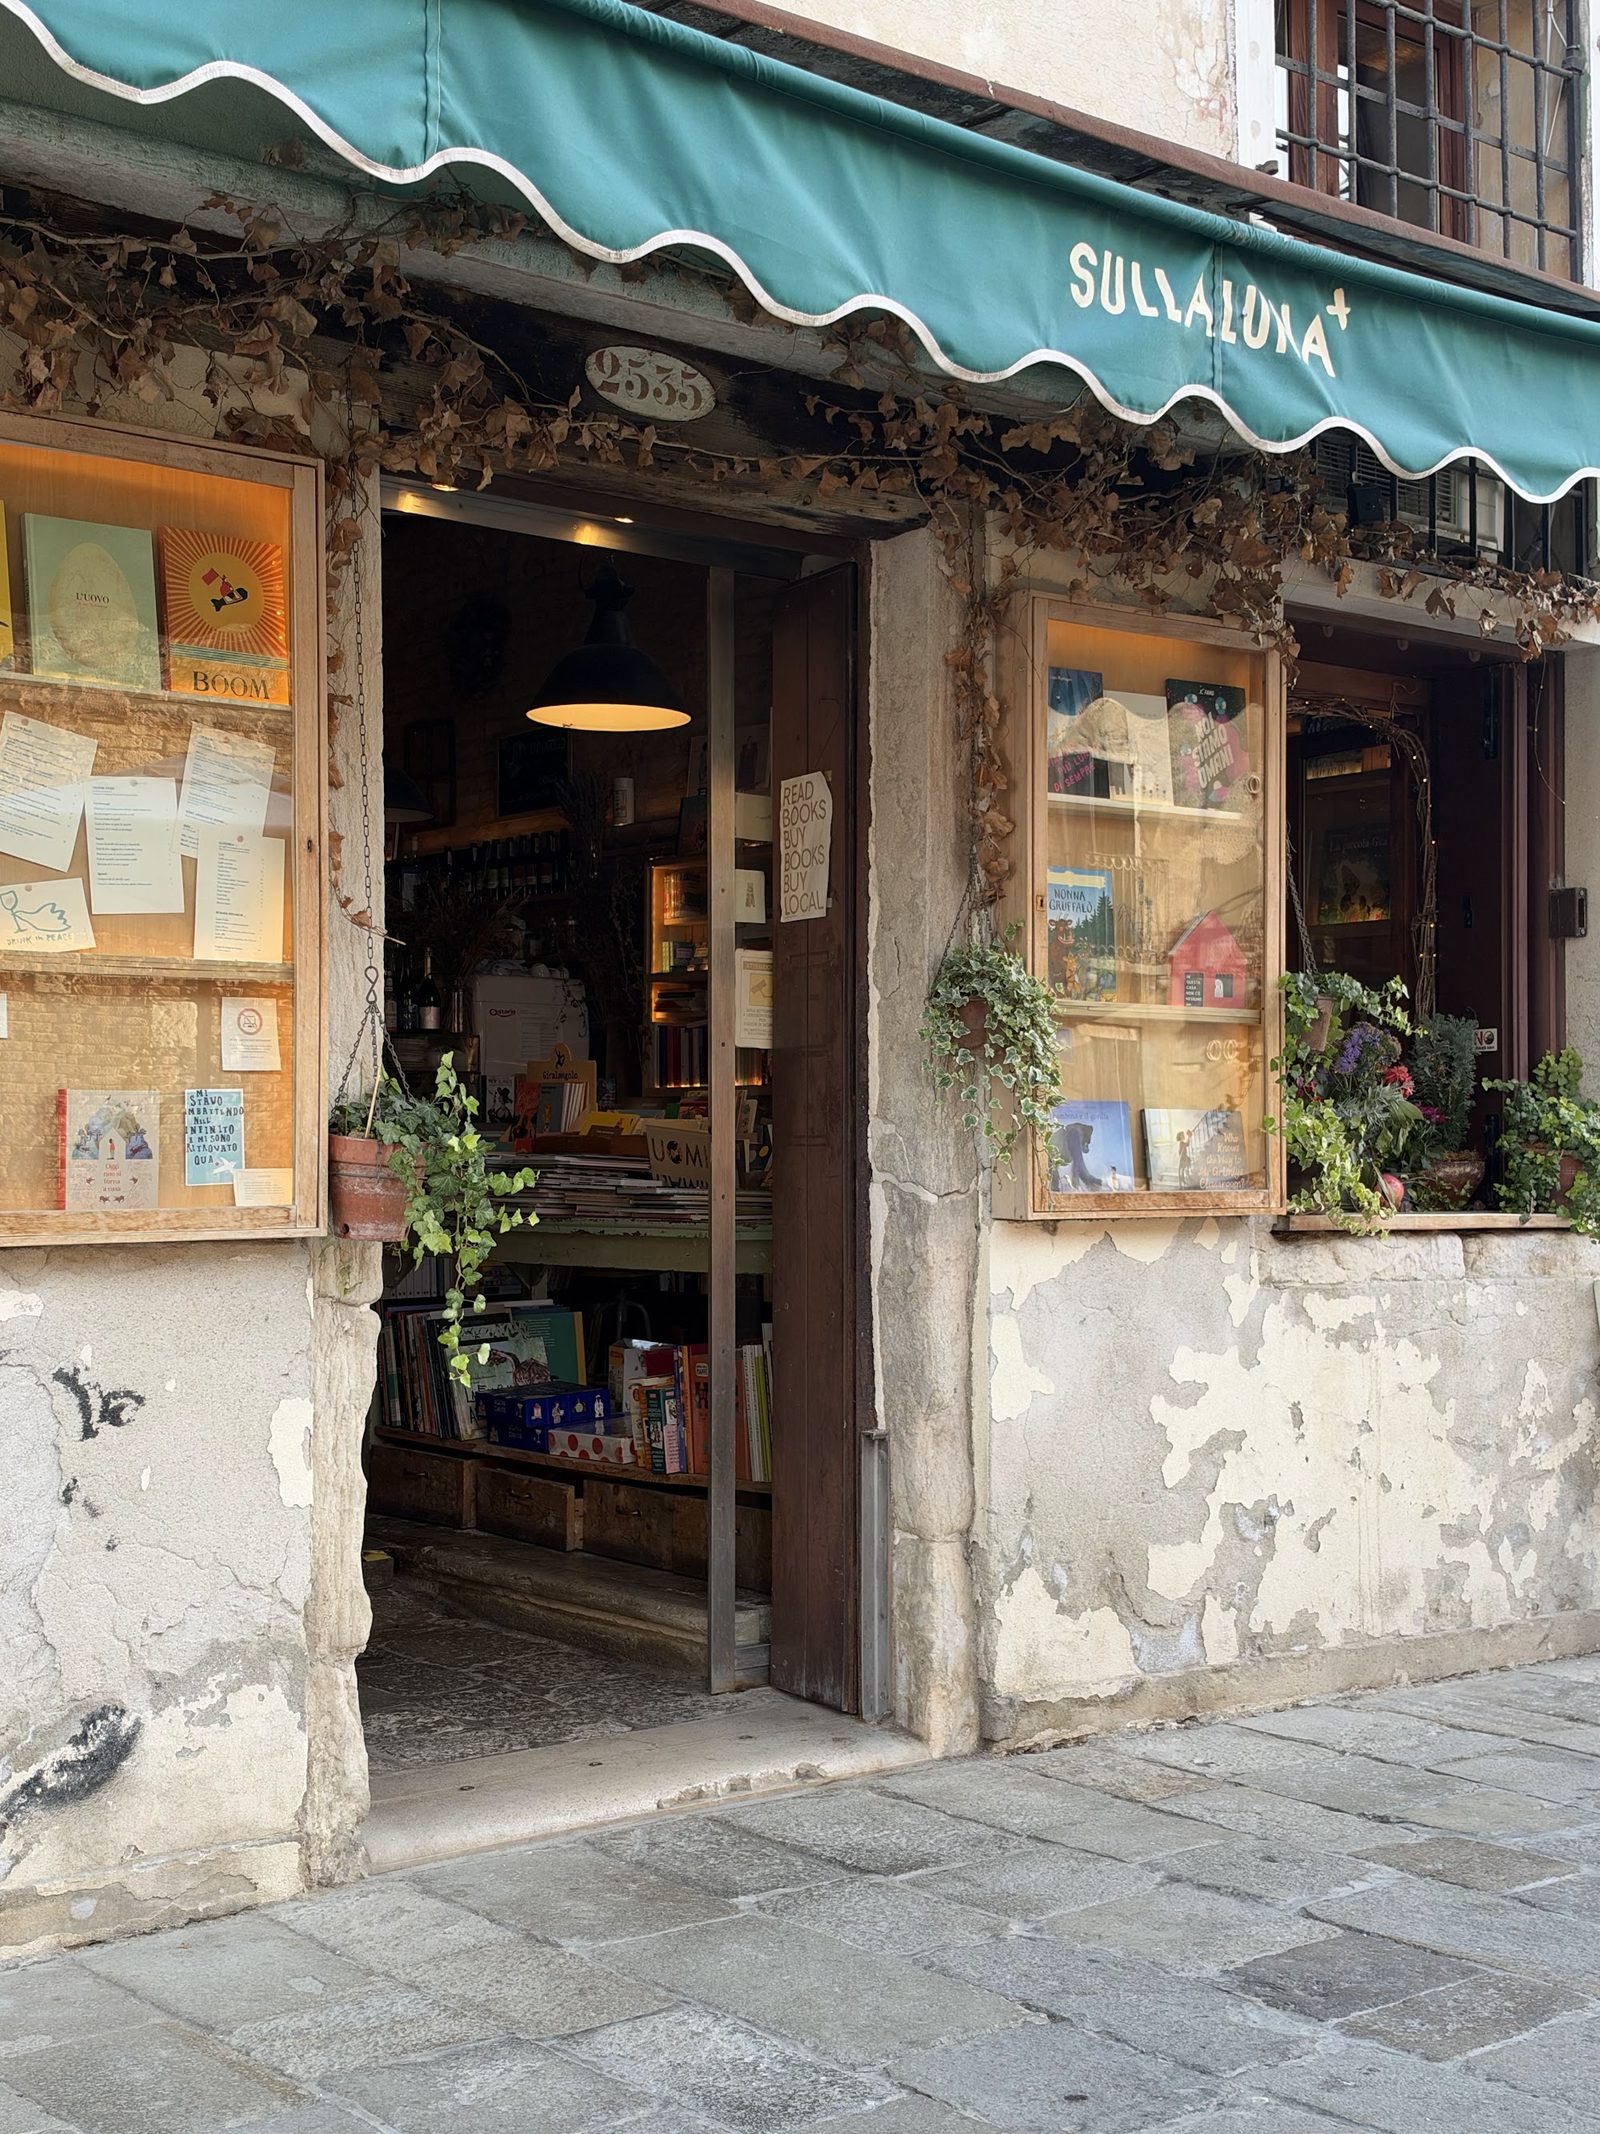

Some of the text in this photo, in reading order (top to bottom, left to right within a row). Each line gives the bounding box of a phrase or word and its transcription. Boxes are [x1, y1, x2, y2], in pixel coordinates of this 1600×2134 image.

[595, 350, 702, 411] 2535
[76, 592, 109, 604] L'UOVO
[193, 671, 269, 699] BOOM
[1192, 724, 1228, 767] SIAMO
[1198, 743, 1233, 789] UMANI
[783, 781, 814, 806] READ
[782, 800, 827, 828] BOOKS
[783, 826, 807, 850] BUY
[784, 844, 825, 872] BOOKS
[783, 871, 808, 894] BUY
[784, 890, 824, 916] LOCAL
[1049, 899, 1093, 913] GRUFFALÒ
[1054, 889, 1086, 901] NONNA
[190, 1096, 222, 1107] STAVO
[196, 1089, 208, 1097] MI
[185, 1125, 235, 1134] INFINITO
[210, 1134, 231, 1142] SONO
[187, 1143, 238, 1152] RITROVATO
[194, 1155, 214, 1165] QUA
